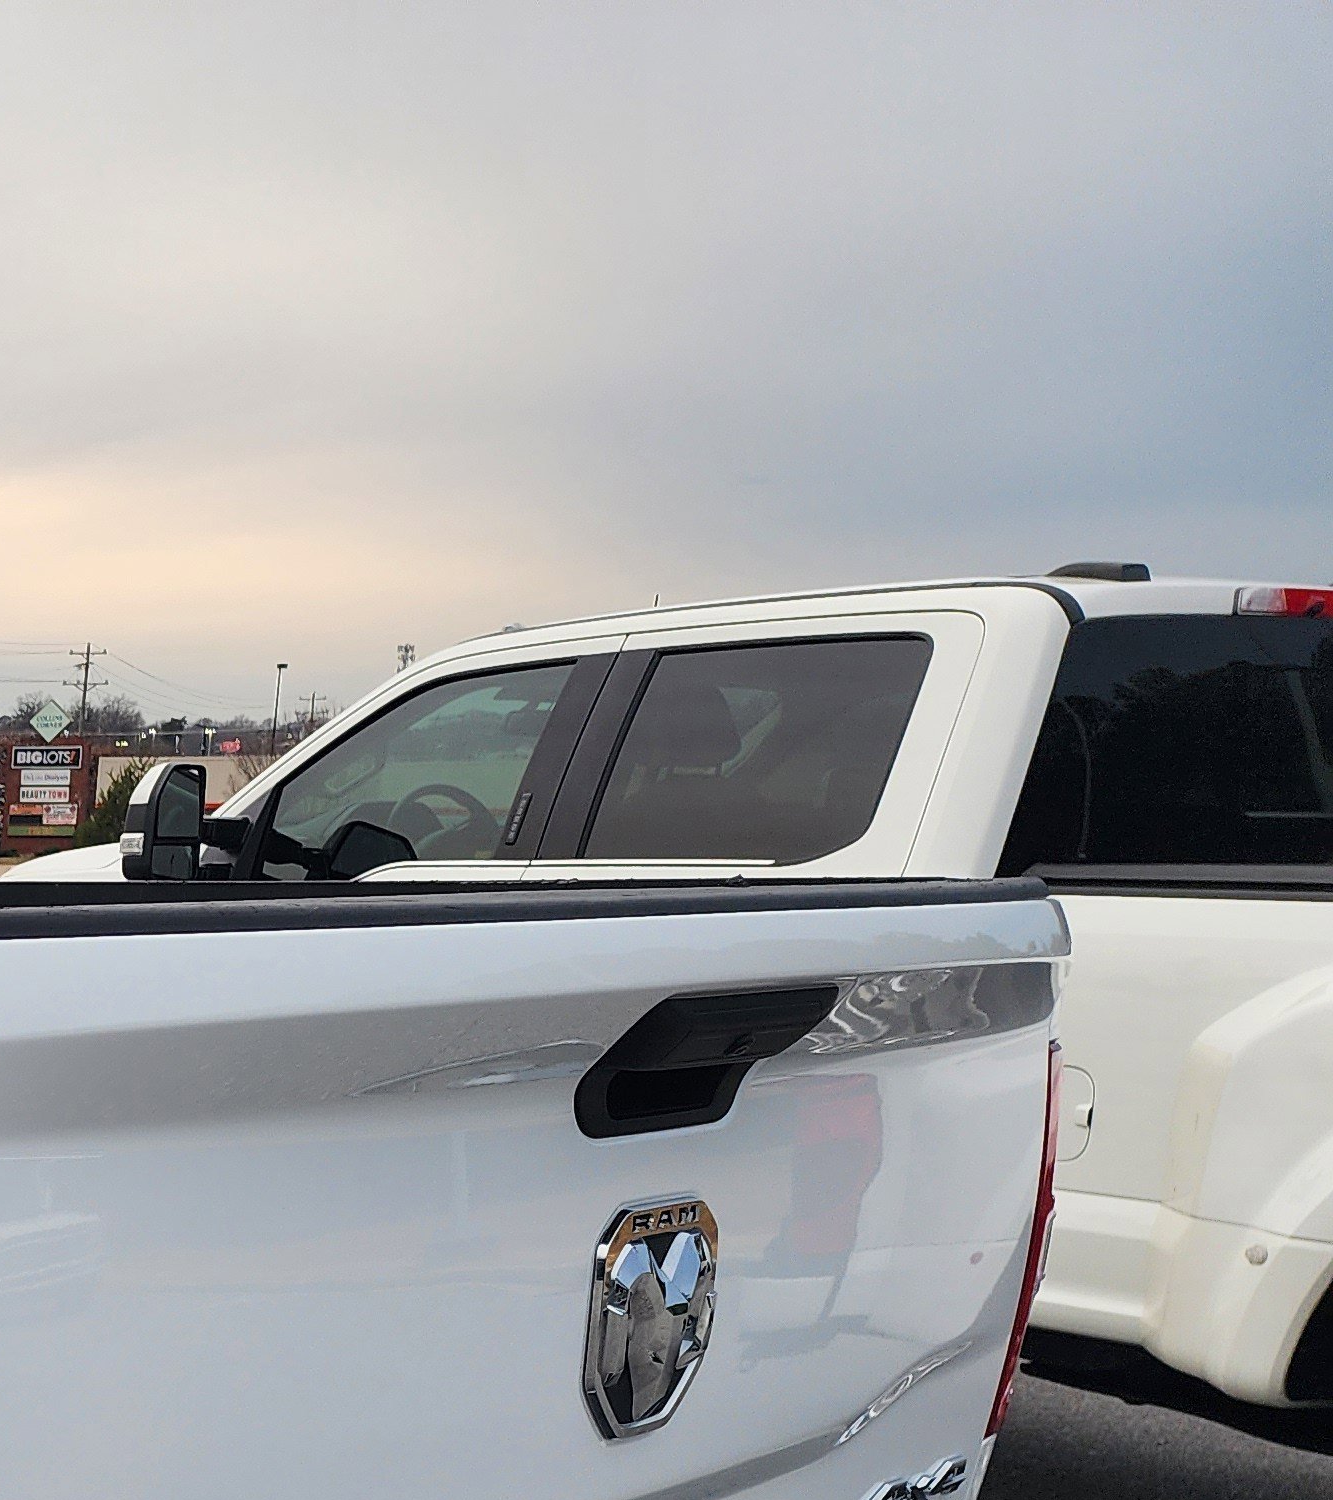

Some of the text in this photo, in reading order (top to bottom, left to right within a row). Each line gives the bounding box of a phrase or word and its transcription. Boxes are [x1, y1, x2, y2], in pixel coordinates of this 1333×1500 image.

[21, 791, 68, 799] BEAUTY TOWN
[632, 1204, 700, 1234] RAM
